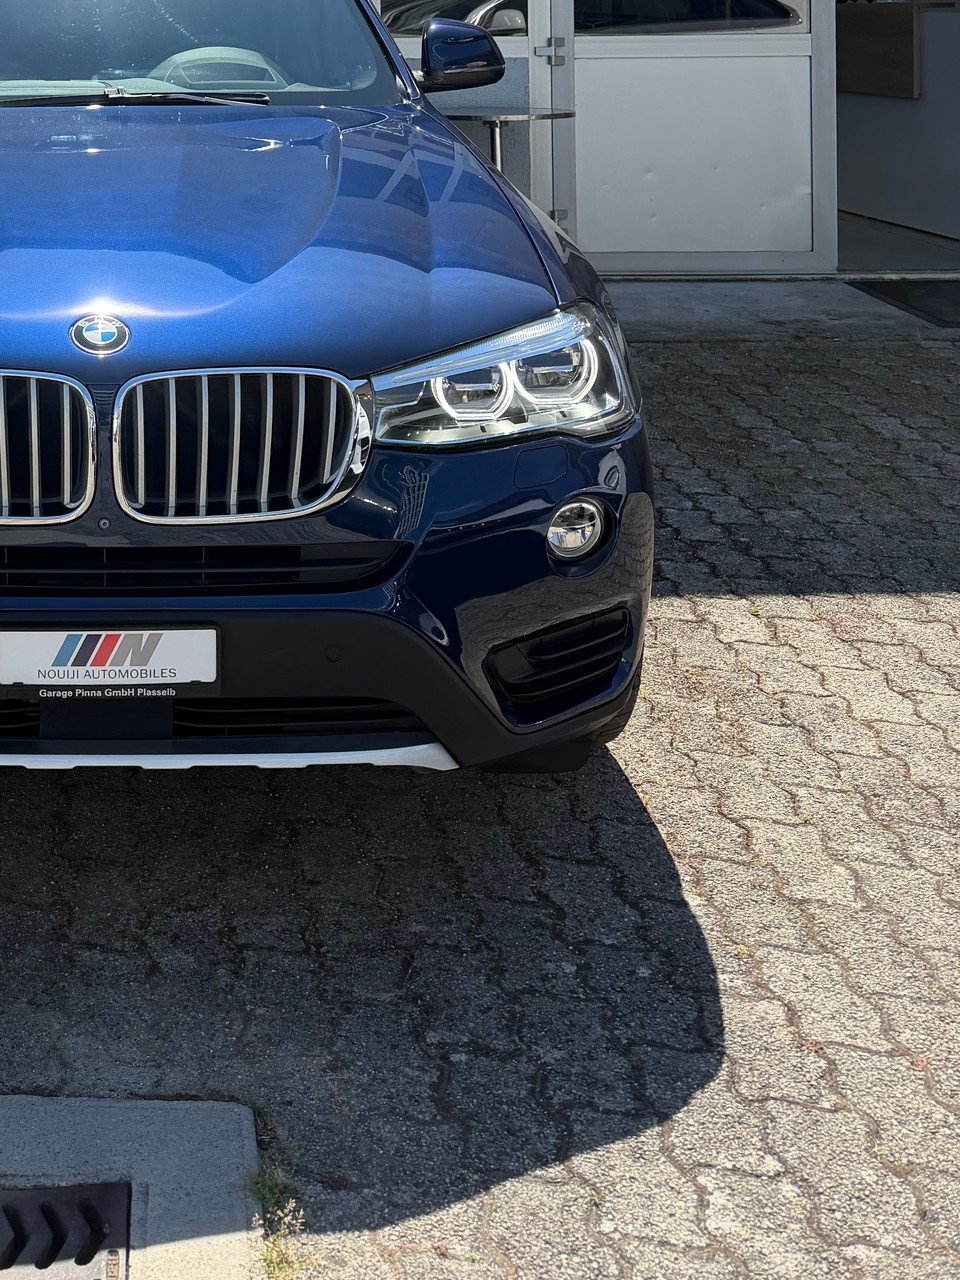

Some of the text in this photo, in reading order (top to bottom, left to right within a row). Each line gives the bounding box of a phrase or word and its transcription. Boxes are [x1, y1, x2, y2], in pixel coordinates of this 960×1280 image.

[37, 668, 177, 679] NOUIJI AUTOMOBILES
[39, 687, 176, 699] Garage Pinna GmbH Plasselb
